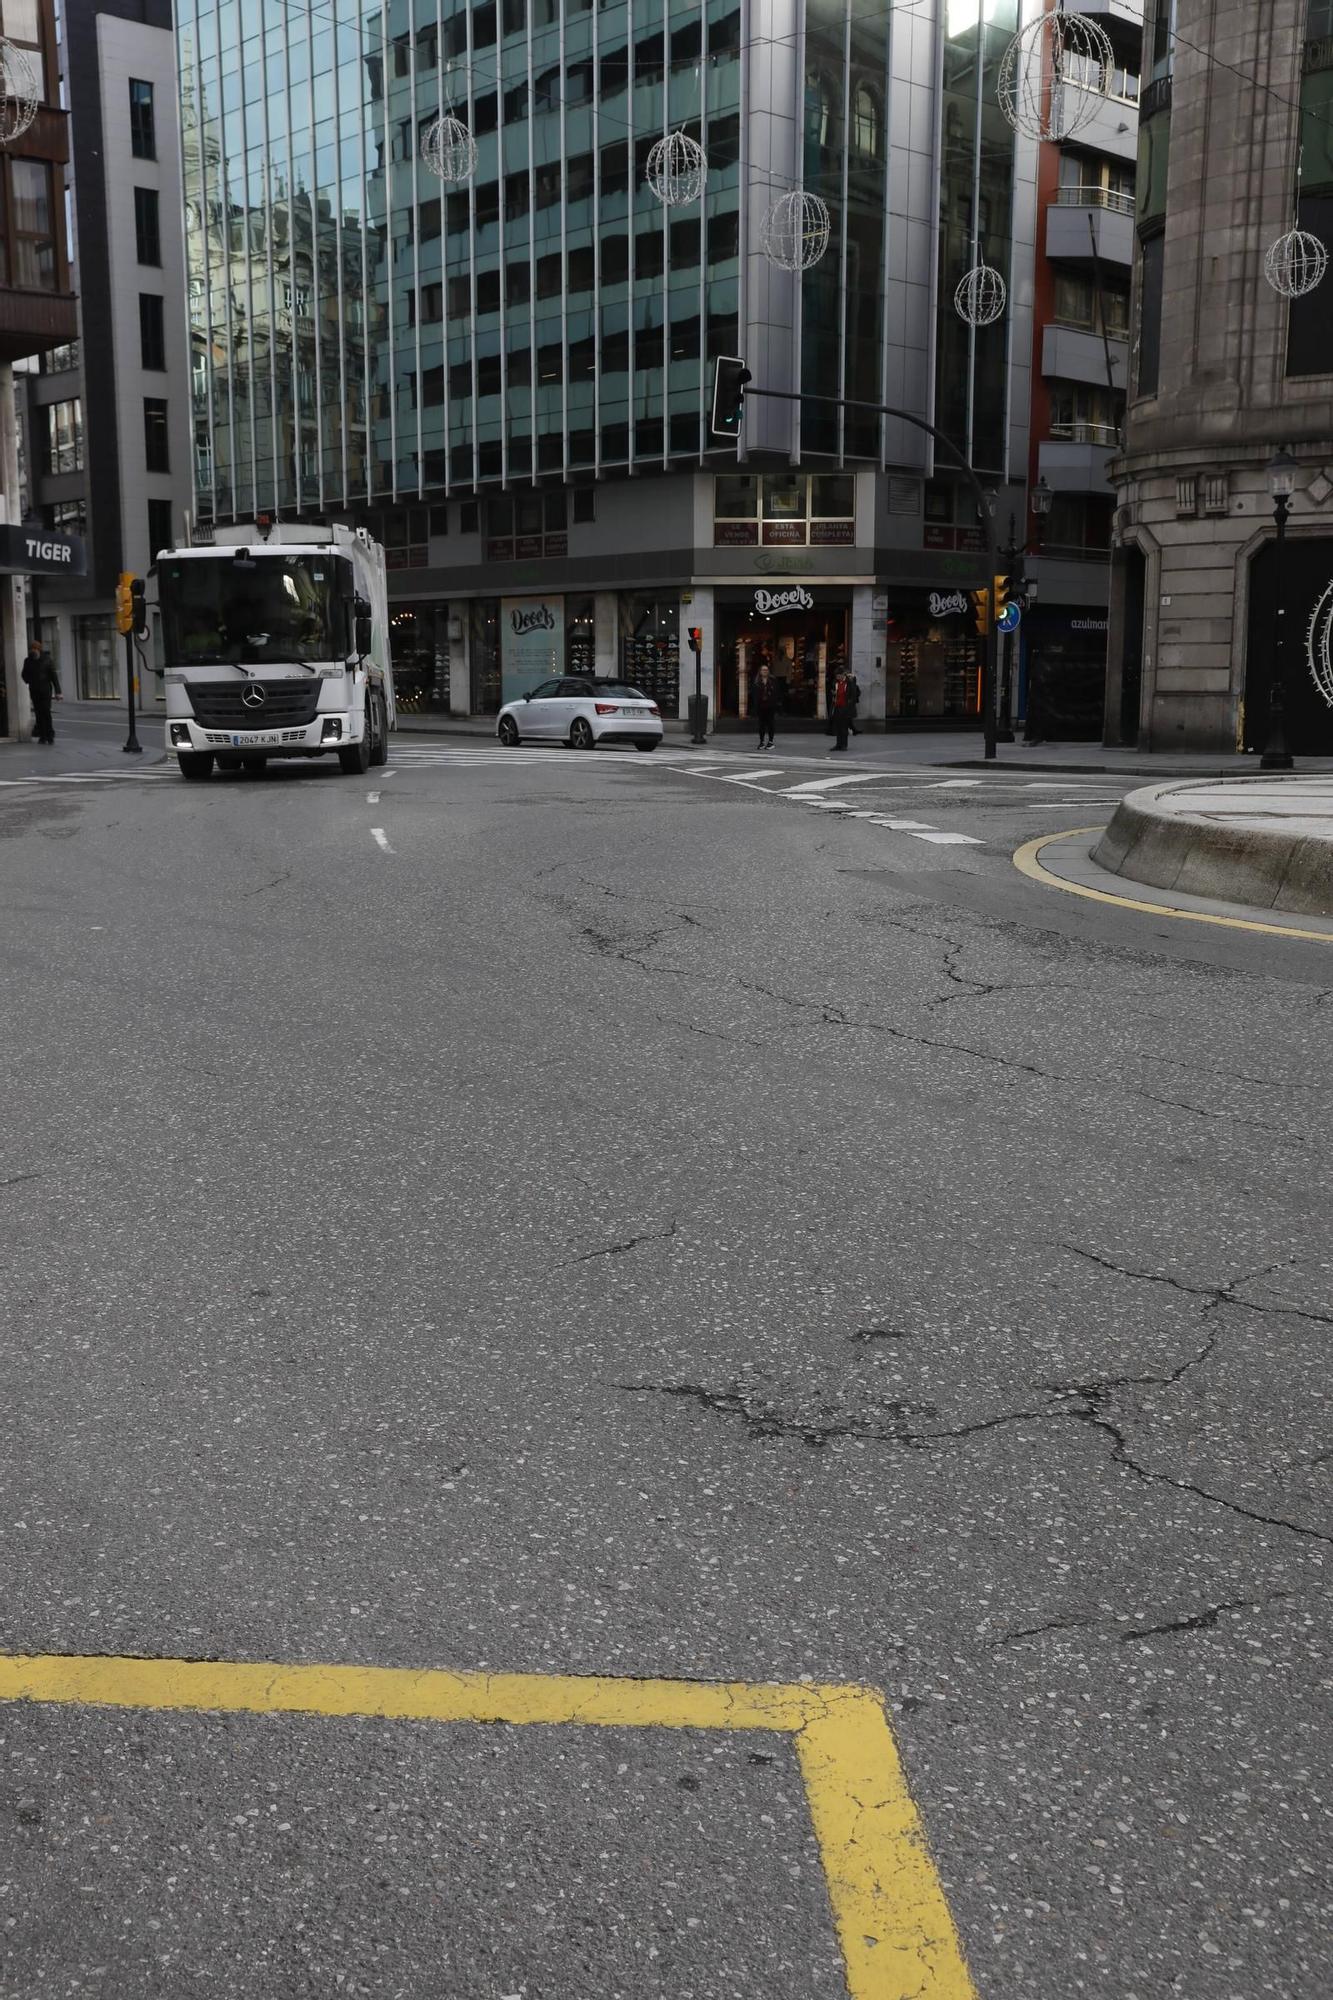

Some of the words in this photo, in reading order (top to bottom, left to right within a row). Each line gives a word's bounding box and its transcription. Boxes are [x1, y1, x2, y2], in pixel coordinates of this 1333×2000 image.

[769, 530, 801, 538] OFICINA
[25, 539, 71, 562] TIGER
[754, 585, 814, 614] Dooers
[929, 589, 967, 617] Dooers
[511, 603, 554, 635] Dooers
[239, 736, 259, 744] 2047
